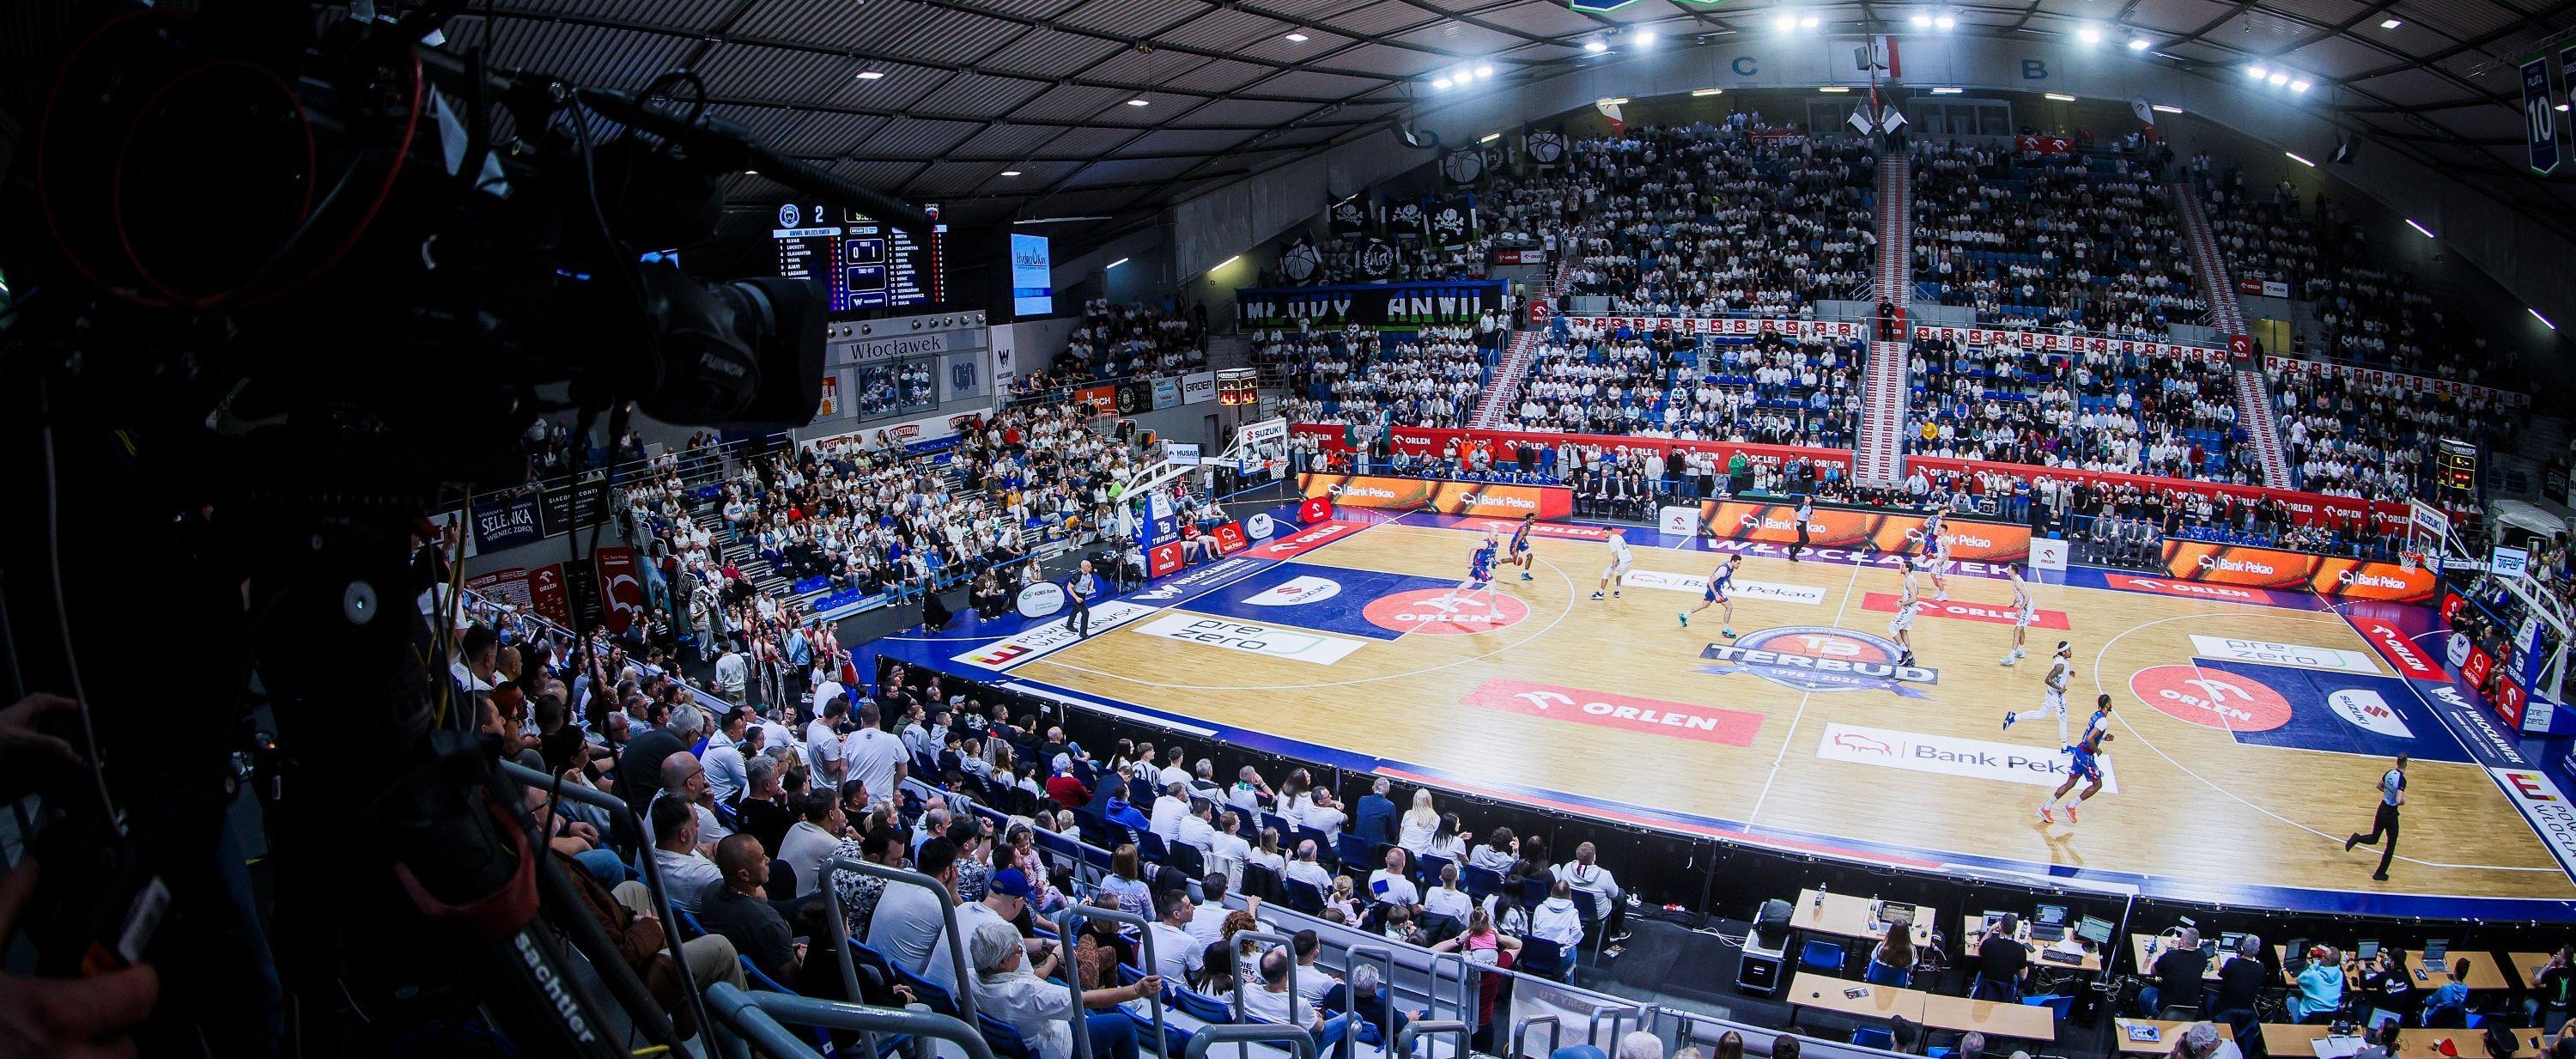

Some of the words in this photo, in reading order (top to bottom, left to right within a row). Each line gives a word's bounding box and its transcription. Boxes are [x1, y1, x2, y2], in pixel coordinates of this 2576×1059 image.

[1731, 57, 1759, 76] C
[2021, 59, 2049, 80] B
[2528, 96, 2553, 143] 10
[815, 205, 823, 223] 2
[854, 247, 859, 259] 0
[872, 246, 876, 258] 1
[850, 335, 942, 360] Włocławek
[699, 352, 747, 379] FUJINON
[1186, 380, 1212, 393] GIRDER
[890, 425, 920, 440] KASZTELAN
[1255, 426, 1281, 440] SUZUKI
[1405, 436, 1431, 445] ORLEN
[1346, 486, 1368, 498] Bank
[1370, 486, 1395, 500] Pekao
[1481, 495, 1502, 507] Bank
[1504, 496, 1535, 509] Pekao
[1765, 517, 1791, 531] Bank
[2420, 514, 2441, 531] SUZUKI
[486, 527, 513, 542] WIENIEC
[1152, 533, 1177, 545] TERBUD
[1295, 524, 1348, 545] ORLEN
[1959, 534, 1991, 549] Pekao
[1223, 543, 1233, 551] Bank
[1232, 541, 1243, 550] Pekao
[1159, 562, 1176, 571] ORLEN
[2221, 558, 2244, 572] Bank
[2245, 562, 2274, 575] Pekao
[539, 582, 557, 593] ORLEN
[2358, 575, 2379, 587] Bank
[2380, 575, 2406, 590] Pekao
[1288, 584, 1334, 603] SUZUKI
[1747, 585, 1816, 599] Pekao
[2172, 584, 2251, 599] ORLEN
[1394, 613, 1492, 624] ORLEN
[1188, 619, 1264, 635] pre
[1170, 629, 1267, 650] zero
[2226, 639, 2285, 652] pre
[1711, 644, 1935, 682] TERBUD
[2233, 650, 2318, 666] zero
[2385, 639, 2430, 673] ORLEN
[1771, 668, 1807, 678] 1998
[2506, 665, 2526, 686] TERBUD
[2159, 689, 2254, 722] ORLEN
[2339, 696, 2370, 726] SUZUKI
[2502, 703, 2515, 719] ORLEN
[2528, 709, 2542, 718] pre
[1583, 703, 1719, 731] ORLEN
[2526, 718, 2544, 727] zero
[2466, 711, 2524, 764] WŁOCŁAWEK
[1915, 745, 1996, 767] Bank
[515, 933, 595, 1043] sachtler
